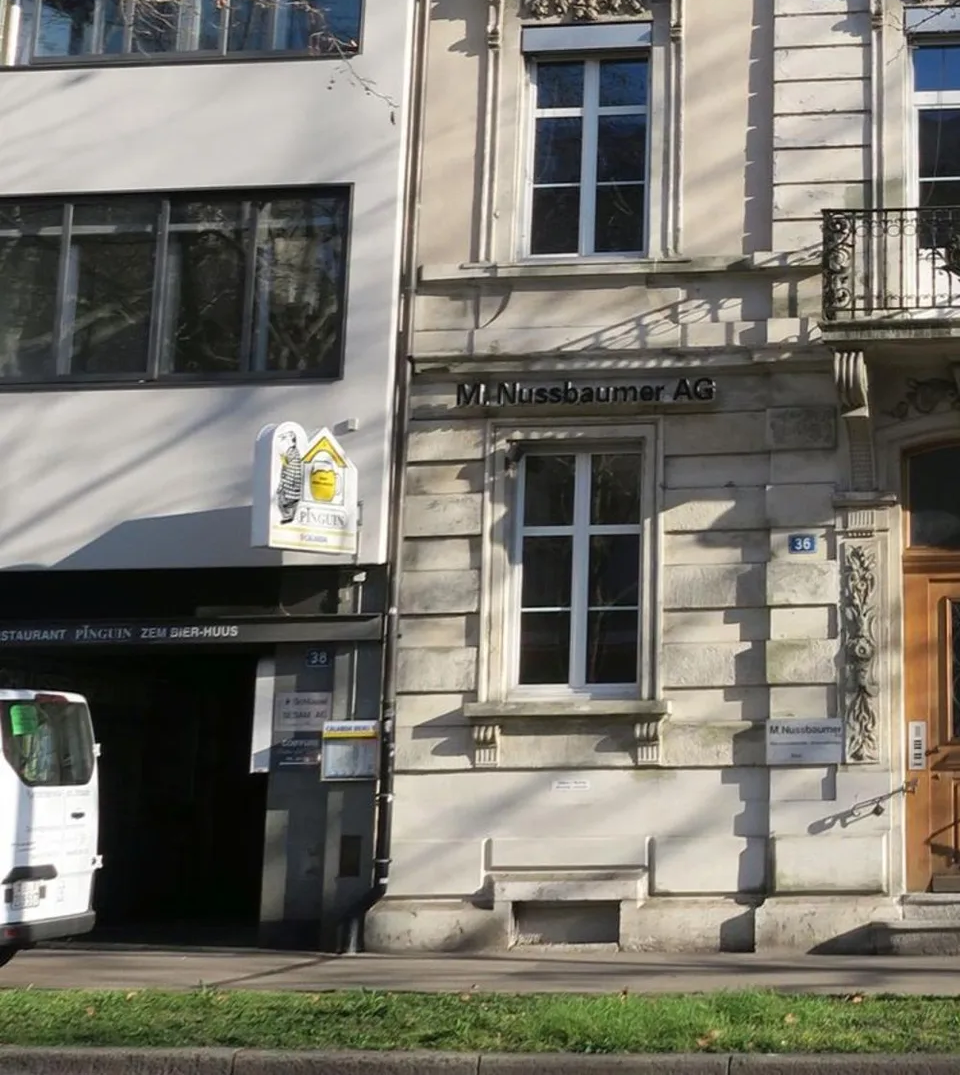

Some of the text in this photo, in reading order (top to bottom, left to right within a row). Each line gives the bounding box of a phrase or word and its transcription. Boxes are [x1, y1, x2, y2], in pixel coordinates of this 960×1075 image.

[456, 378, 716, 406] M. Nussbaumer AG
[794, 537, 812, 550] 36
[140, 627, 167, 639] ZEM
[169, 625, 239, 639] BIER-HUUS
[310, 651, 328, 664] 38
